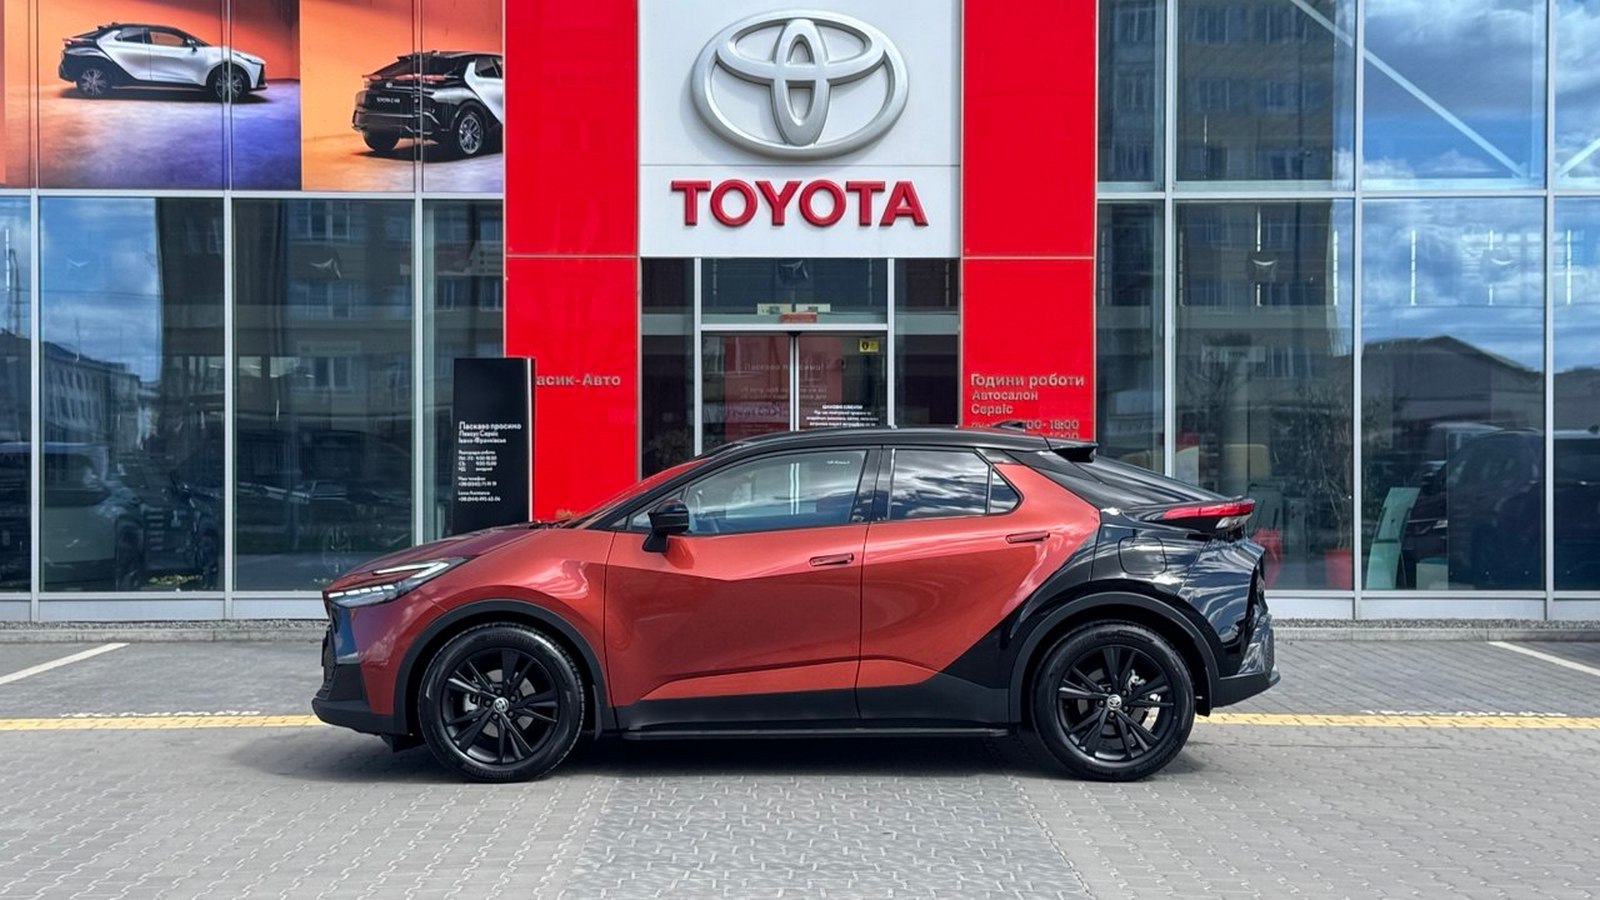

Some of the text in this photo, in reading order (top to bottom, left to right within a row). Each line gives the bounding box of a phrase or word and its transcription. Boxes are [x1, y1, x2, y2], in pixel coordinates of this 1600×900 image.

[671, 179, 929, 228] TOYOTA
[536, 374, 621, 386] асик-Авто
[970, 373, 1085, 389] Години роботи
[972, 391, 1039, 401] Автосалон
[971, 403, 1014, 416] Сервіс
[1049, 419, 1080, 431] 18:00
